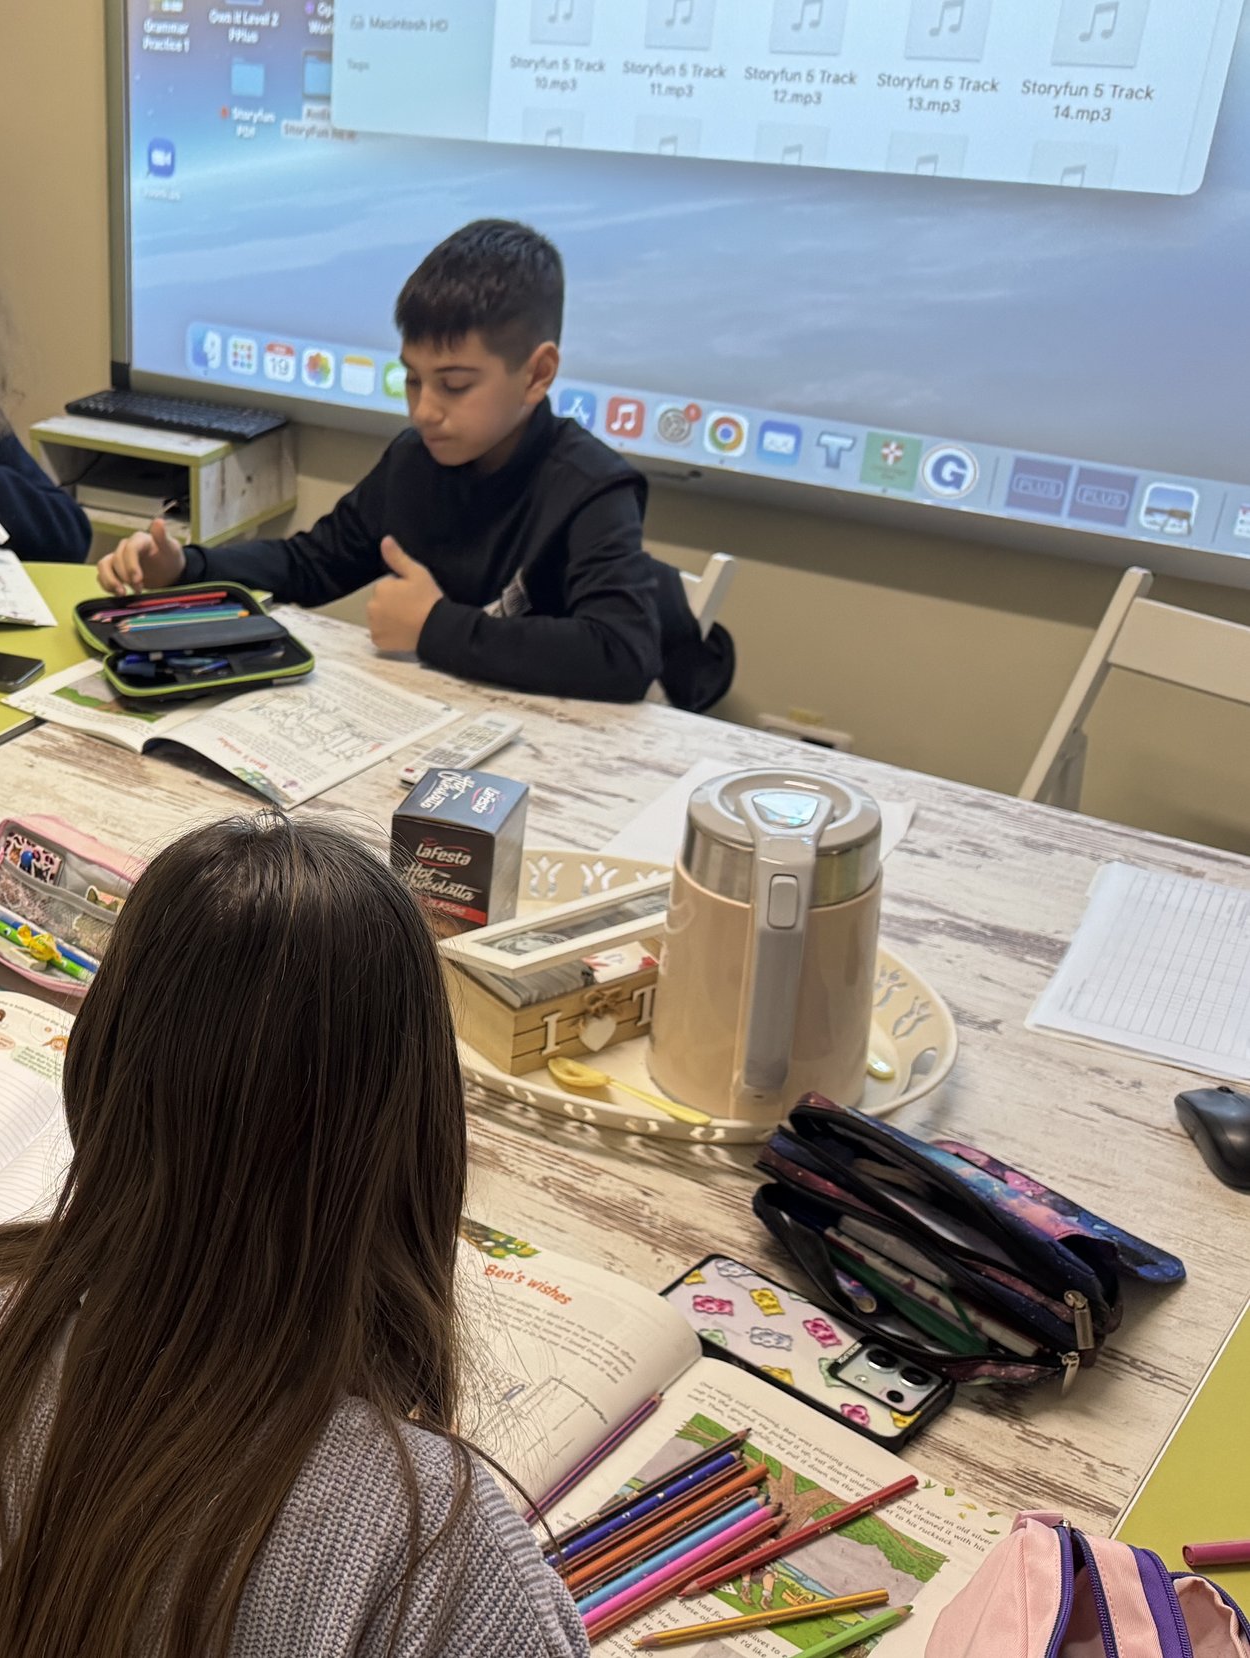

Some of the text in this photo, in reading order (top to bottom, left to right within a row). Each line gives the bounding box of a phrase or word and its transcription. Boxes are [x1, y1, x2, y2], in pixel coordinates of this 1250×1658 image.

[144, 18, 190, 35] Grammar
[370, 15, 449, 32] Macintosh HD
[510, 55, 606, 73] Storyfun 5 Track
[622, 60, 727, 80] Storyfun 5 Track
[535, 76, 578, 92] 10.mp3
[744, 66, 857, 87] Storyfun 5 Track
[877, 72, 1001, 94] Storyfun 5 Track
[650, 82, 694, 99] 11.mp3
[772, 88, 823, 106] 12.mp3
[1021, 79, 1155, 102] Storyfun 5 Track
[907, 97, 961, 115] 13.mp3
[1053, 105, 1112, 123] 14.mp3
[269, 356, 290, 377] 19
[415, 843, 472, 866] LaFesta
[406, 862, 452, 879] Hot
[484, 1263, 573, 1306] Ben's wishes
[758, 1422, 769, 1431] He
[769, 1430, 794, 1446] picked
[814, 1457, 827, 1466] sat
[826, 1464, 849, 1480] down
[849, 1477, 872, 1492] under
[797, 1437, 813, 1448] was
[812, 1446, 844, 1468] planting
[844, 1464, 865, 1479] some
[775, 1442, 786, 1452] he
[785, 1450, 801, 1461] put
[807, 1464, 829, 1479] down
[829, 1476, 841, 1486] on
[841, 1482, 854, 1493] the
[894, 1512, 905, 1522] to
[905, 1518, 918, 1530] his
[896, 1503, 913, 1516] and
[913, 1513, 945, 1532] cleaned
[953, 1533, 972, 1547] with
[972, 1542, 986, 1553] his
[913, 1502, 994, 1546] he saw an old silver
[696, 1598, 713, 1611] had
[642, 1621, 655, 1632] He
[657, 1619, 670, 1630] He
[665, 1612, 681, 1625] hot
[740, 1638, 768, 1658] I'd like
[750, 1631, 771, 1649] olives
[770, 1646, 782, 1656] to
